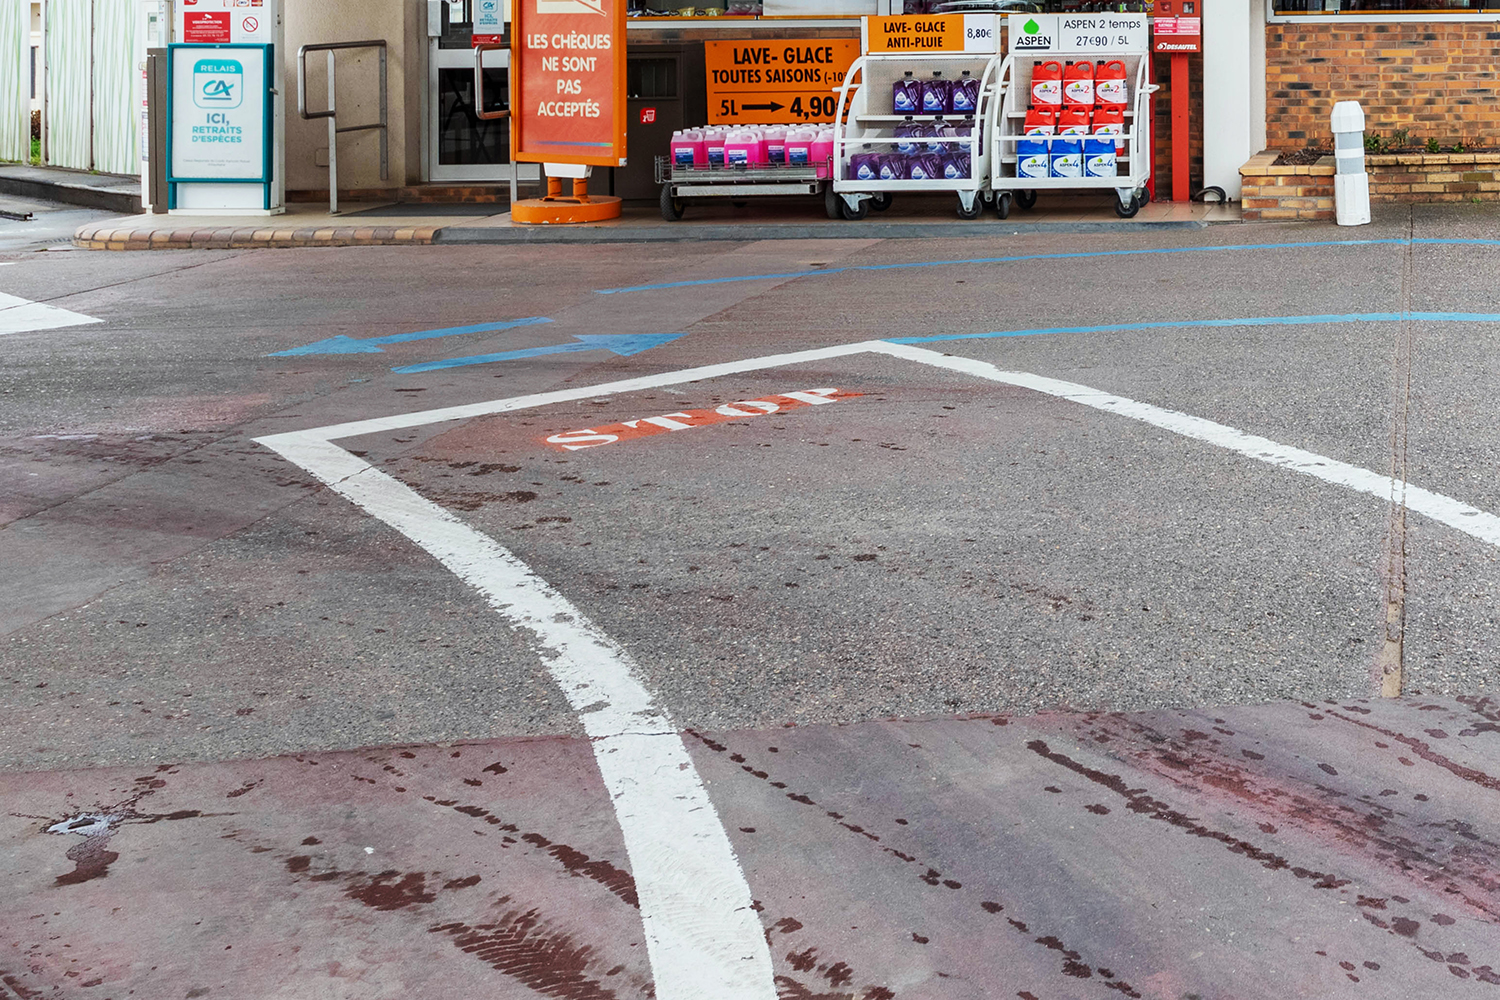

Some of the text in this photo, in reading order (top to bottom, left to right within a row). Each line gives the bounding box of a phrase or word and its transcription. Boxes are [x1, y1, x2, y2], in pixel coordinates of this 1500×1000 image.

[884, 22, 945, 33] LAVE- GLACE
[1064, 20, 1141, 30] ASPEN 2 temps
[967, 28, 992, 39] 8,80€
[527, 31, 611, 50] LES CHÈQUES
[887, 37, 943, 48] ANTI-PLUIE
[1016, 36, 1051, 45] ASPEN
[1076, 36, 1108, 46] 27€90
[1118, 36, 1129, 45] 5L
[733, 47, 833, 65] LAVE- GLACE
[542, 57, 597, 71] NE SONT
[712, 69, 761, 83] TOUTES
[765, 68, 821, 83] SAISONS
[556, 79, 582, 94] PAS
[1052, 86, 1058, 94] 2
[1084, 85, 1090, 93] 2
[1114, 85, 1120, 93] 2
[537, 98, 600, 117] ACCEPTÉS
[721, 99, 738, 116] 5L
[206, 113, 230, 126] ICI,
[192, 126, 242, 134] RETRAITS
[192, 134, 242, 143] D'ESPÈCES
[1040, 160, 1047, 168] 4
[1072, 160, 1079, 168] 4
[1106, 160, 1113, 168] 4
[546, 387, 840, 451] STOP
